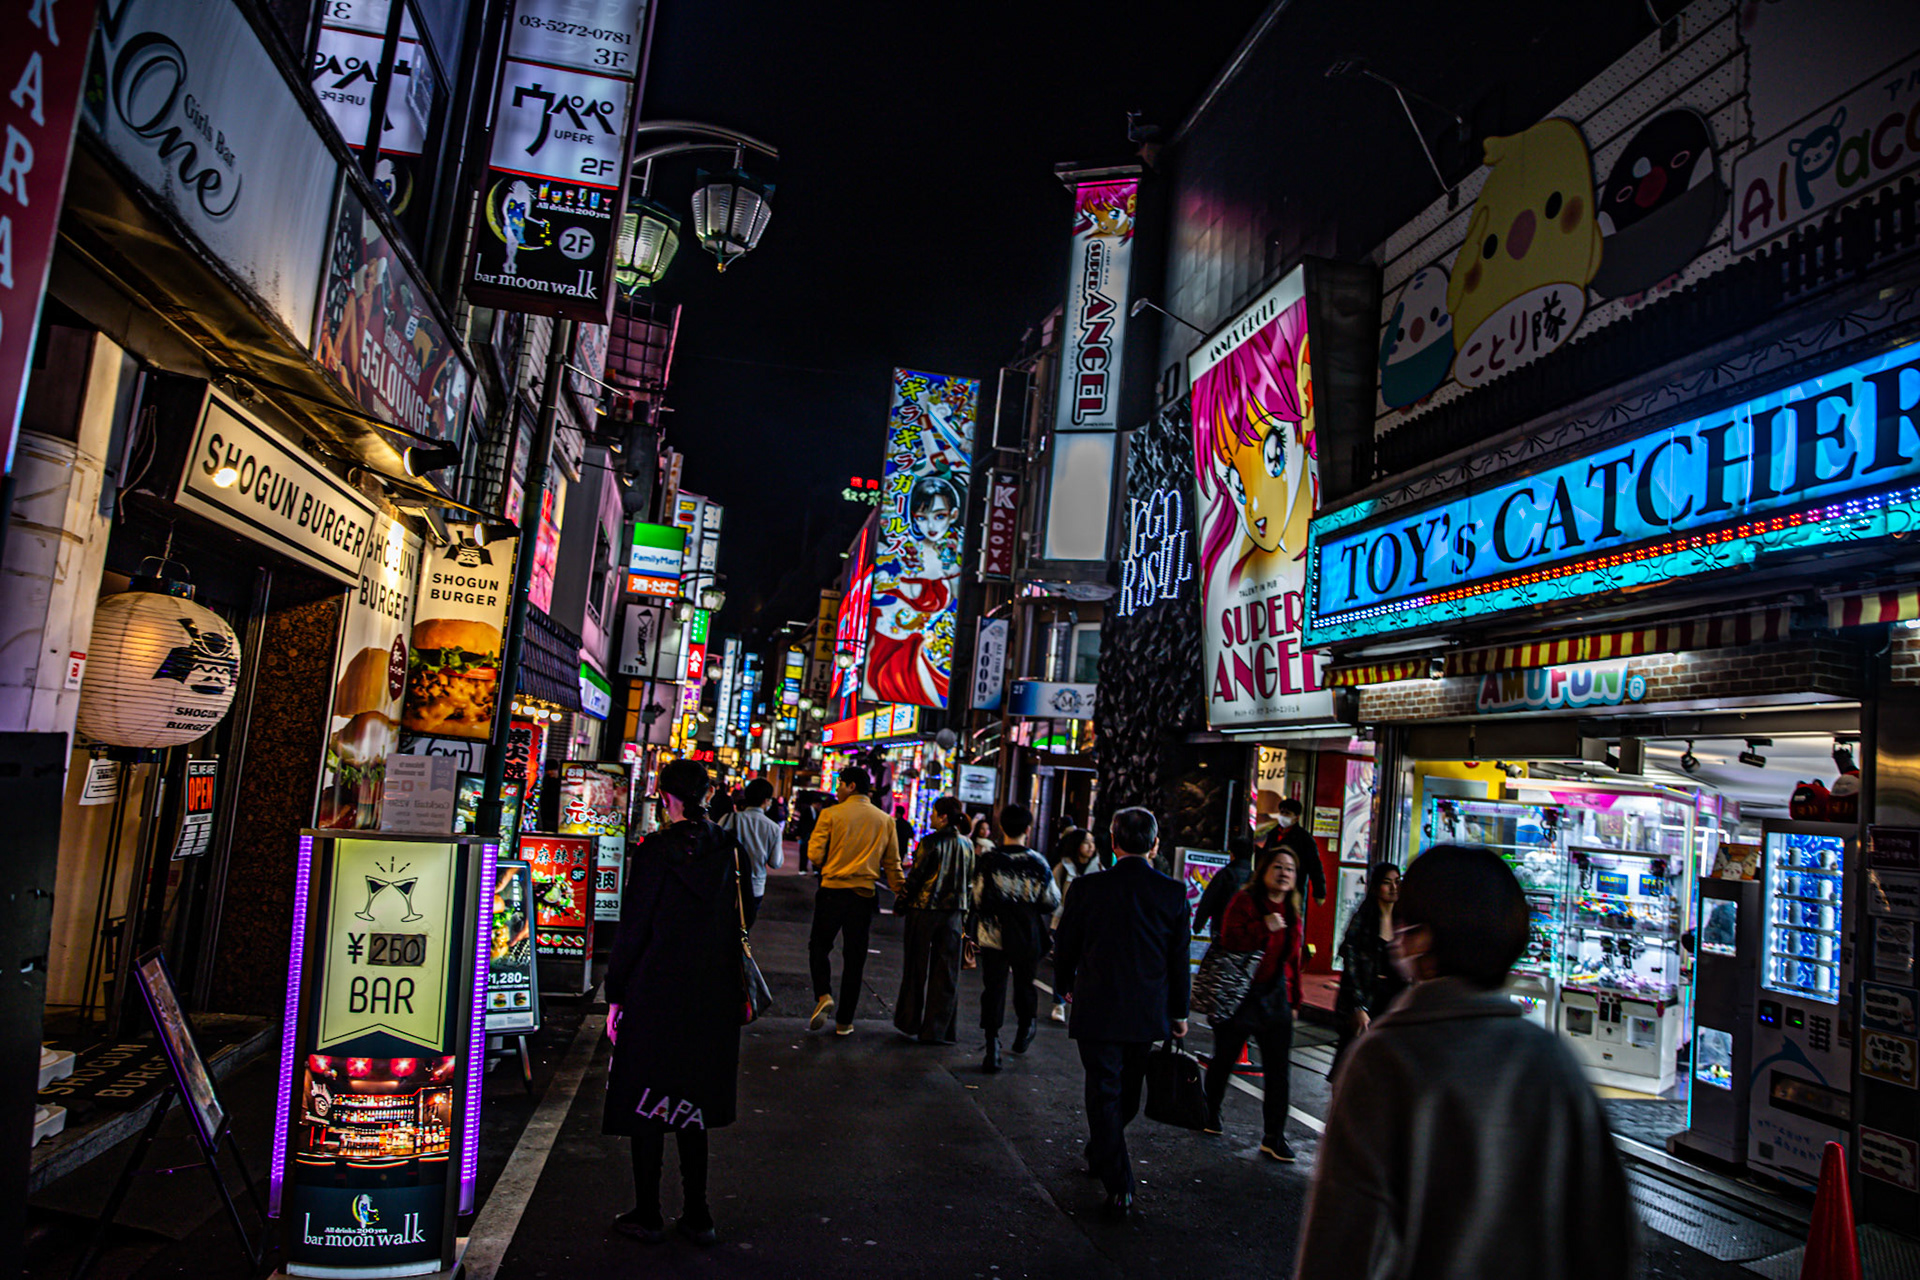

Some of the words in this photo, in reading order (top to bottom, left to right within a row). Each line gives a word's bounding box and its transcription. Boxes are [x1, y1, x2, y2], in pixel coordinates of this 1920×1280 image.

[519, 14, 633, 46] 03-5272-0781
[593, 47, 629, 68] 3F
[112, 32, 243, 217] One
[183, 93, 213, 146] Girls
[212, 130, 237, 168] Bar
[512, 82, 617, 156] ウペペ
[554, 129, 594, 145] UPEPE
[580, 157, 614, 176] 2F
[552, 203, 575, 214] drinks
[563, 233, 592, 252] 2F
[474, 253, 497, 284] bar
[1088, 241, 1103, 291] SUPER
[1469, 291, 1566, 378] ことり隊
[1076, 291, 1114, 419] ANGEL
[886, 374, 928, 557] ギラギラガールズ
[1342, 513, 1477, 604] TOY's
[1494, 358, 1920, 565] CATCHER
[203, 433, 299, 520] SHOGUN
[297, 492, 366, 558] BURGER
[987, 485, 1017, 573] KADOYA
[633, 552, 680, 566] FamilyMart
[431, 589, 497, 607] BURGER
[432, 573, 499, 591] SHOGUN
[632, 578, 677, 594] 酒・たばこ
[1222, 590, 1304, 648] SUPER
[1212, 638, 1326, 704] ANGEL
[1481, 668, 1618, 704] AMUFUN
[188, 776, 214, 811] OPEN
[572, 869, 585, 880] 3F
[349, 975, 415, 1015] BAR
[38, 1044, 149, 1095] SHOGUN
[635, 1087, 705, 1130] LAPA
[303, 1212, 322, 1246] bar
